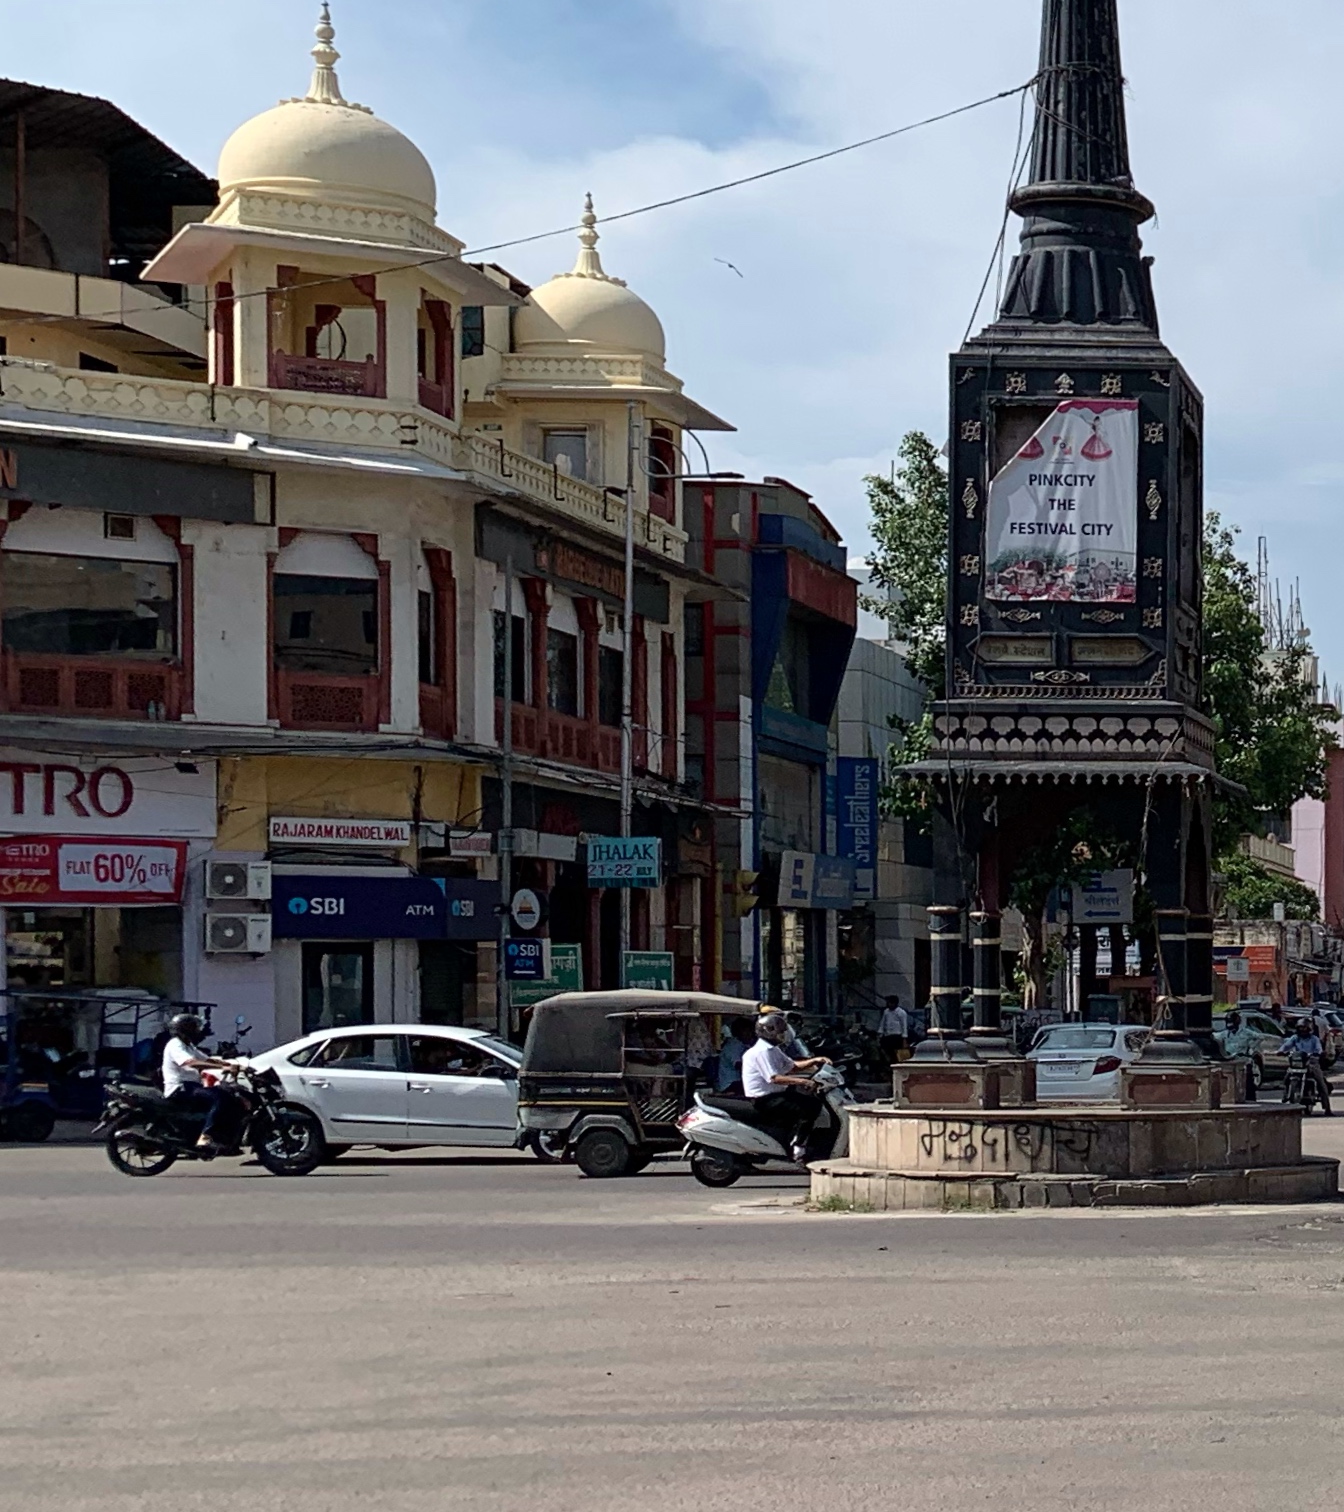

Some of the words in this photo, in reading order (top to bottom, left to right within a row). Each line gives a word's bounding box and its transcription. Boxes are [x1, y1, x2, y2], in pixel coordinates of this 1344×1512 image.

[1029, 474, 1096, 487] PINKCITY
[1049, 498, 1076, 511] THE
[1009, 522, 1077, 536] FESTIVAL
[1081, 523, 1114, 536] CITY
[272, 823, 334, 838] RAJARAM
[335, 825, 409, 841] KHANDELWAL
[591, 844, 654, 861] JHALAK
[66, 860, 91, 875] FLAT
[94, 852, 147, 884] 60%
[310, 897, 345, 915] SBI
[405, 904, 434, 916] ATM
[460, 901, 475, 917] SBI
[519, 945, 540, 957] SBI
[514, 958, 535, 968] ATM
